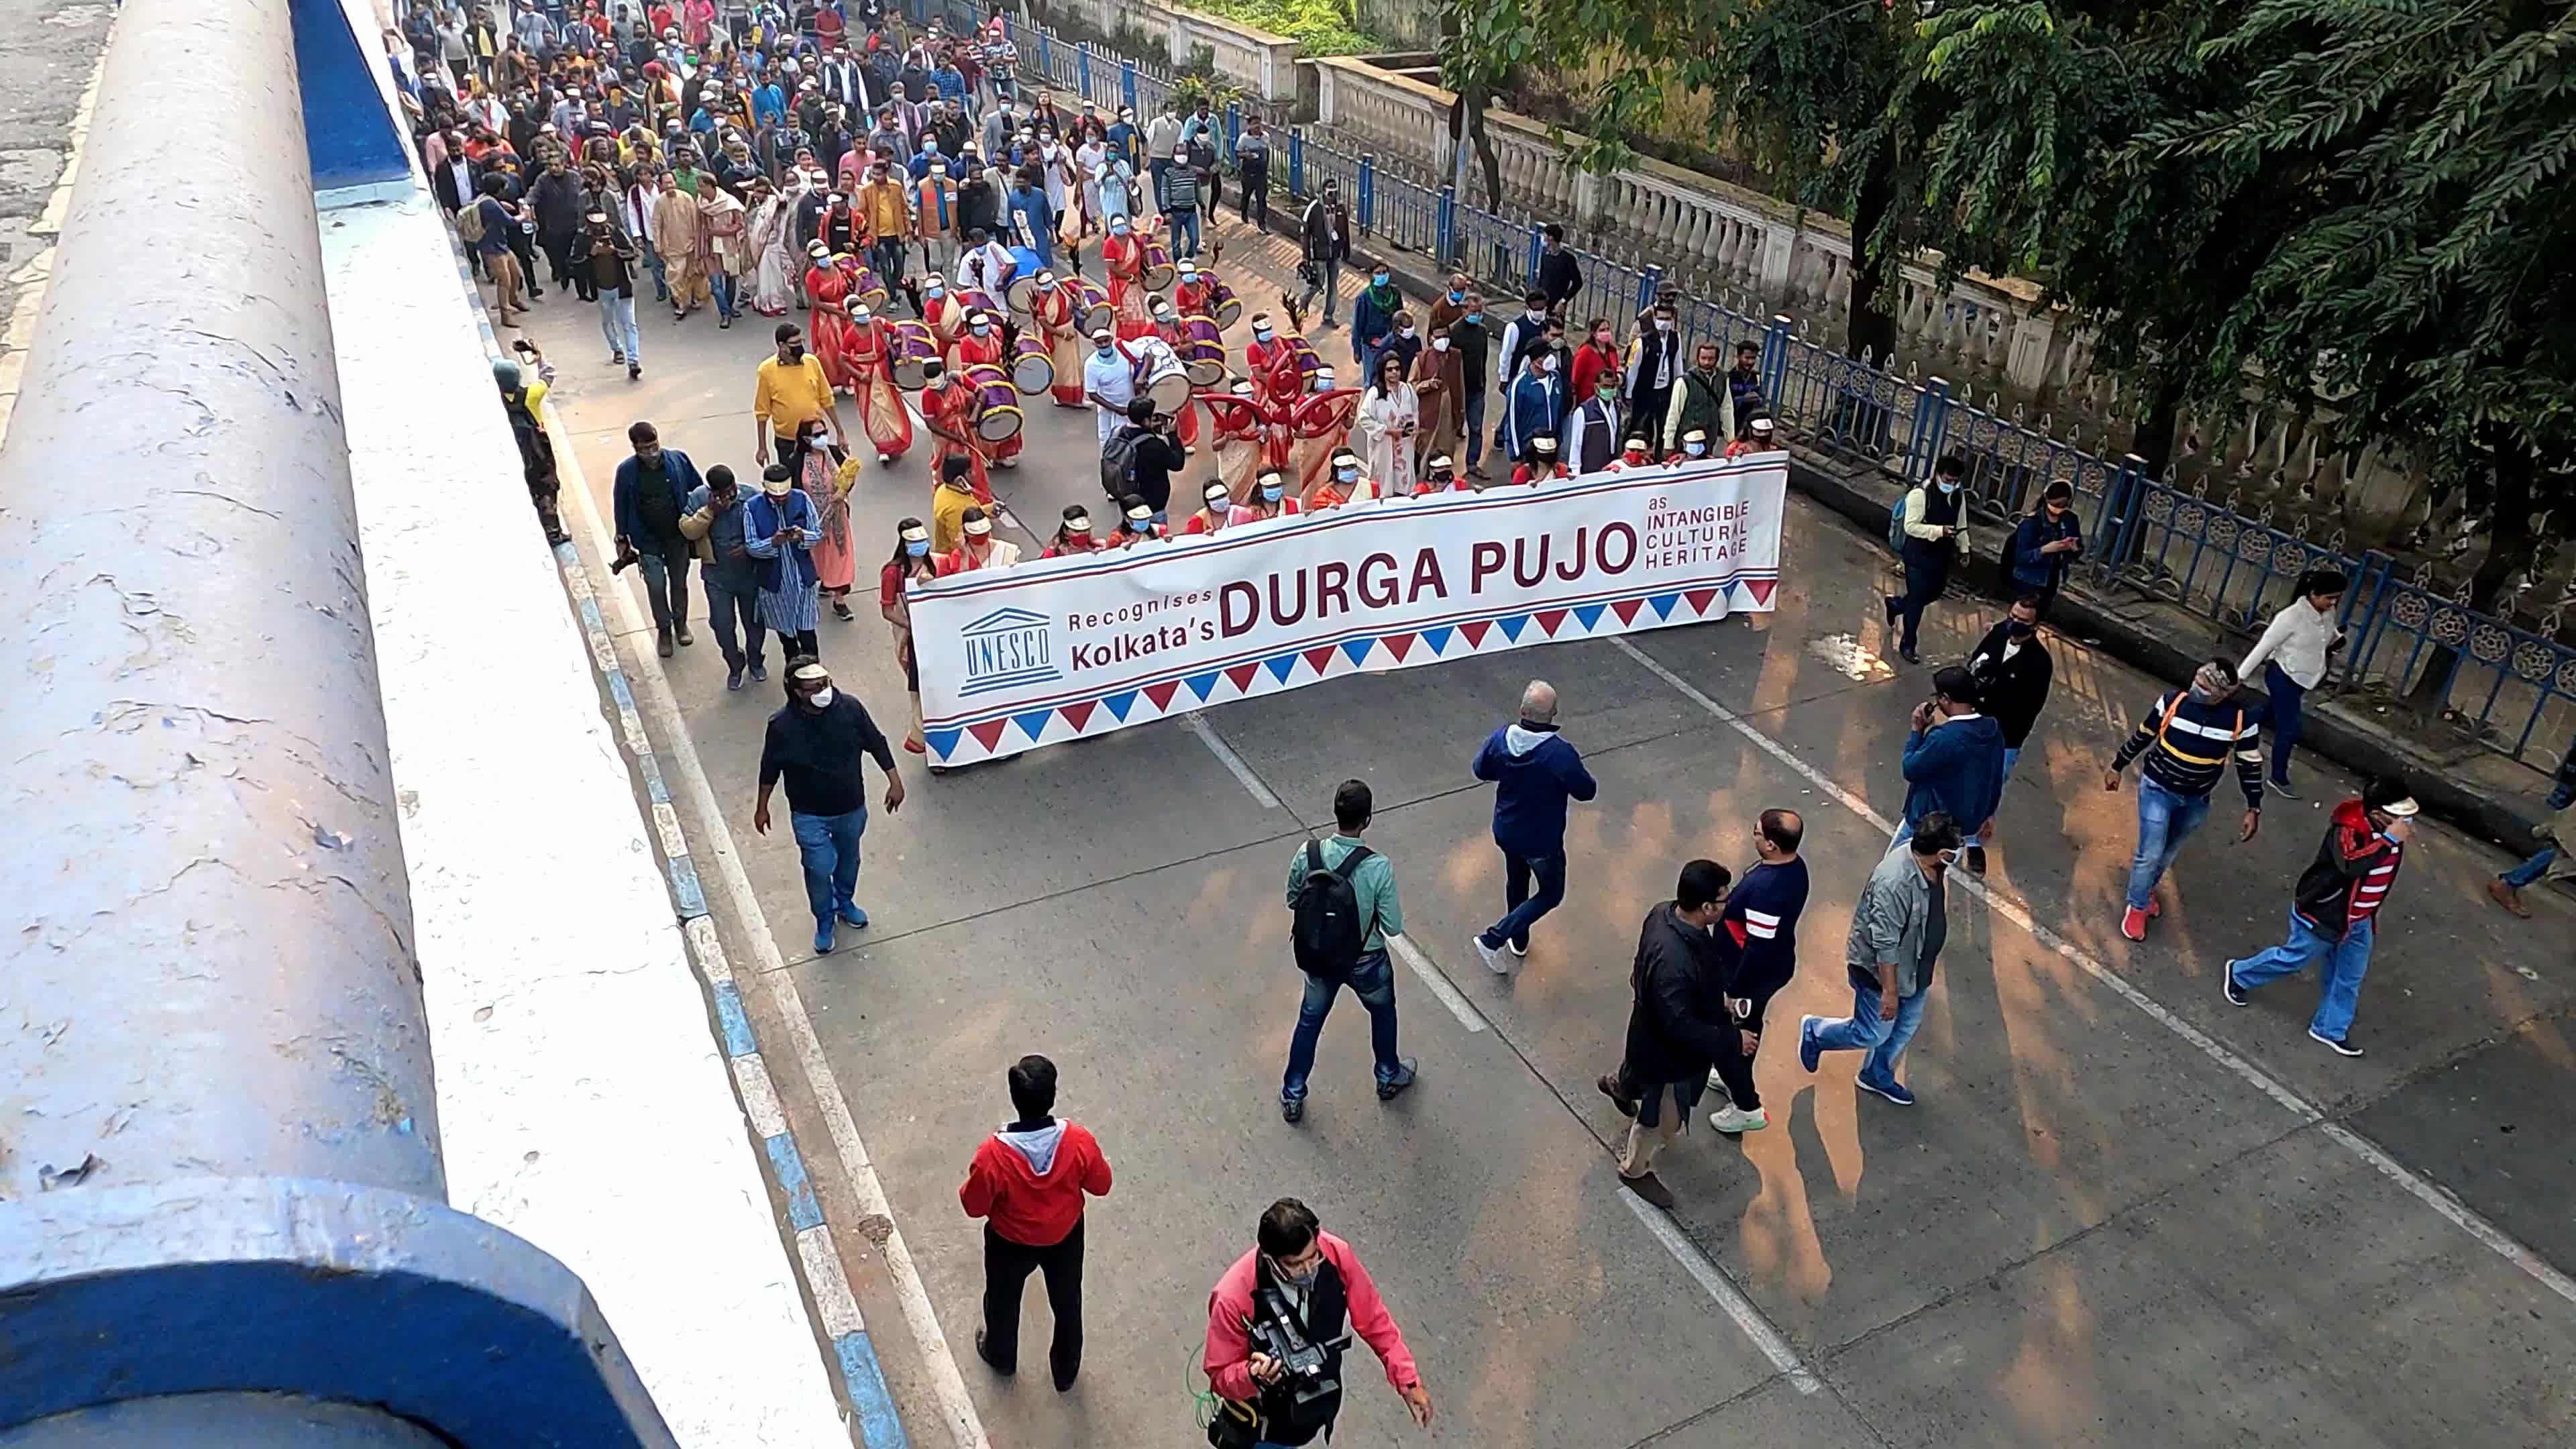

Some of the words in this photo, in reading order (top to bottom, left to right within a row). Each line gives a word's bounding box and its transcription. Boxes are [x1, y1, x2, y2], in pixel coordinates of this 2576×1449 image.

[1648, 500, 1750, 531] INTANGIBLE
[1649, 497, 1667, 510] as
[1646, 520, 1747, 549] CULTURAL
[1646, 538, 1747, 569] HERITAGE
[1069, 590, 1212, 631] Recognises
[1073, 617, 1214, 671] Kolkata's
[1220, 547, 1448, 639] DURGA
[1471, 521, 1637, 594] PUJO
[965, 628, 1050, 676] UNESCO
